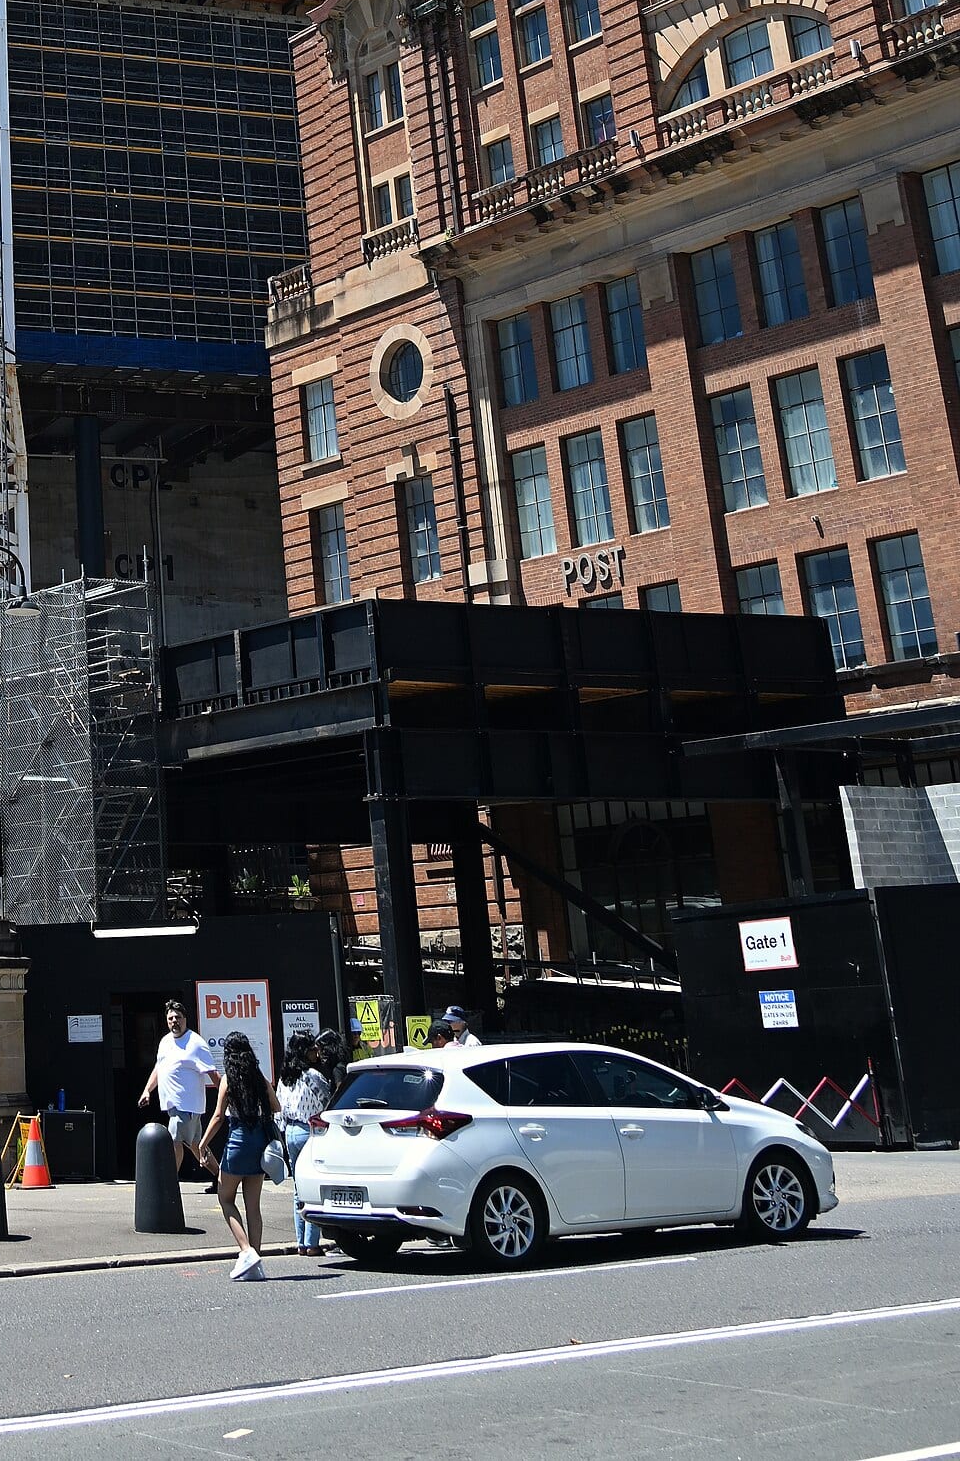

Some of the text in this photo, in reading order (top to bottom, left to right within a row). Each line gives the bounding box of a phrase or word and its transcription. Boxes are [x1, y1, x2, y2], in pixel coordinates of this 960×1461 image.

[560, 546, 622, 589] POST
[746, 933, 786, 950] Gate 1
[205, 994, 261, 1019] Built
[764, 993, 790, 1002] NOTICE
